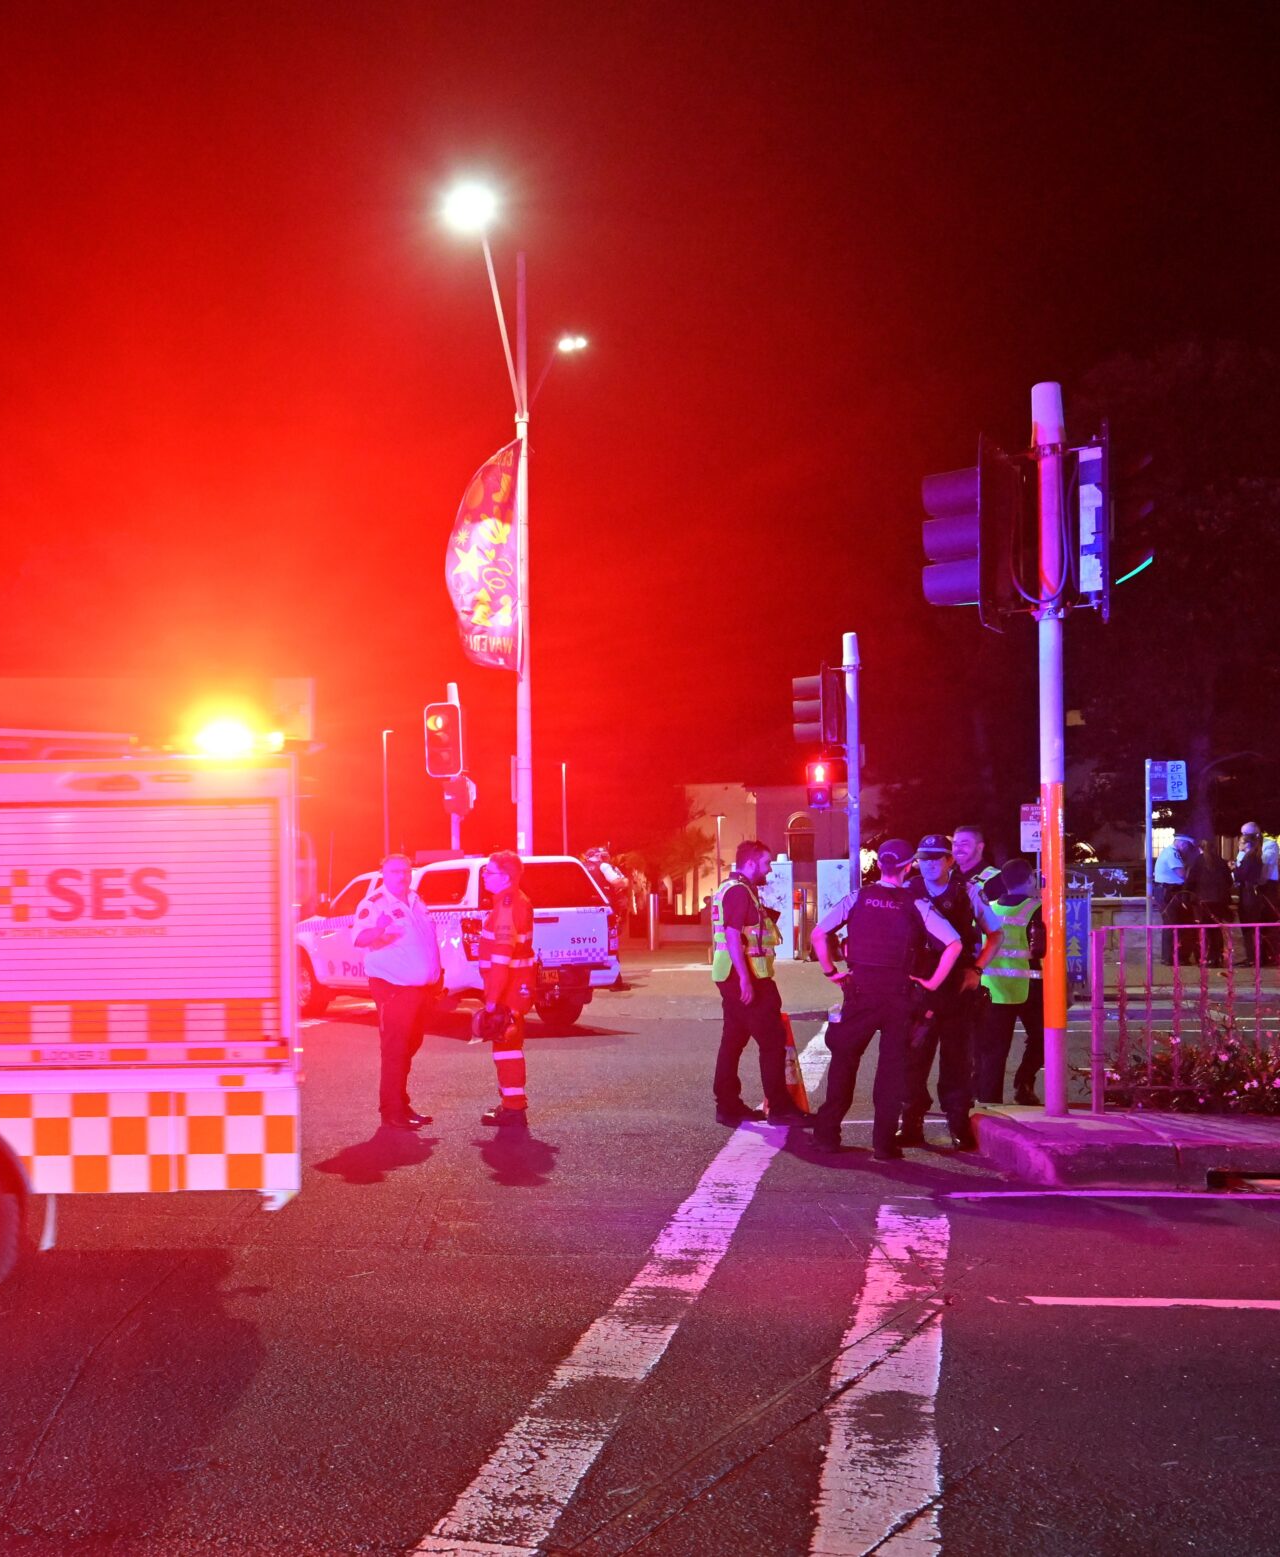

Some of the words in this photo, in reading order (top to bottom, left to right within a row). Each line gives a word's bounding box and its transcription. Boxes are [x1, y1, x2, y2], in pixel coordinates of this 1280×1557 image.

[1170, 764, 1182, 772] 2P
[1171, 781, 1183, 789] 2P
[46, 867, 170, 921] SES
[570, 936, 597, 945] SSY10
[550, 950, 564, 958] 131
